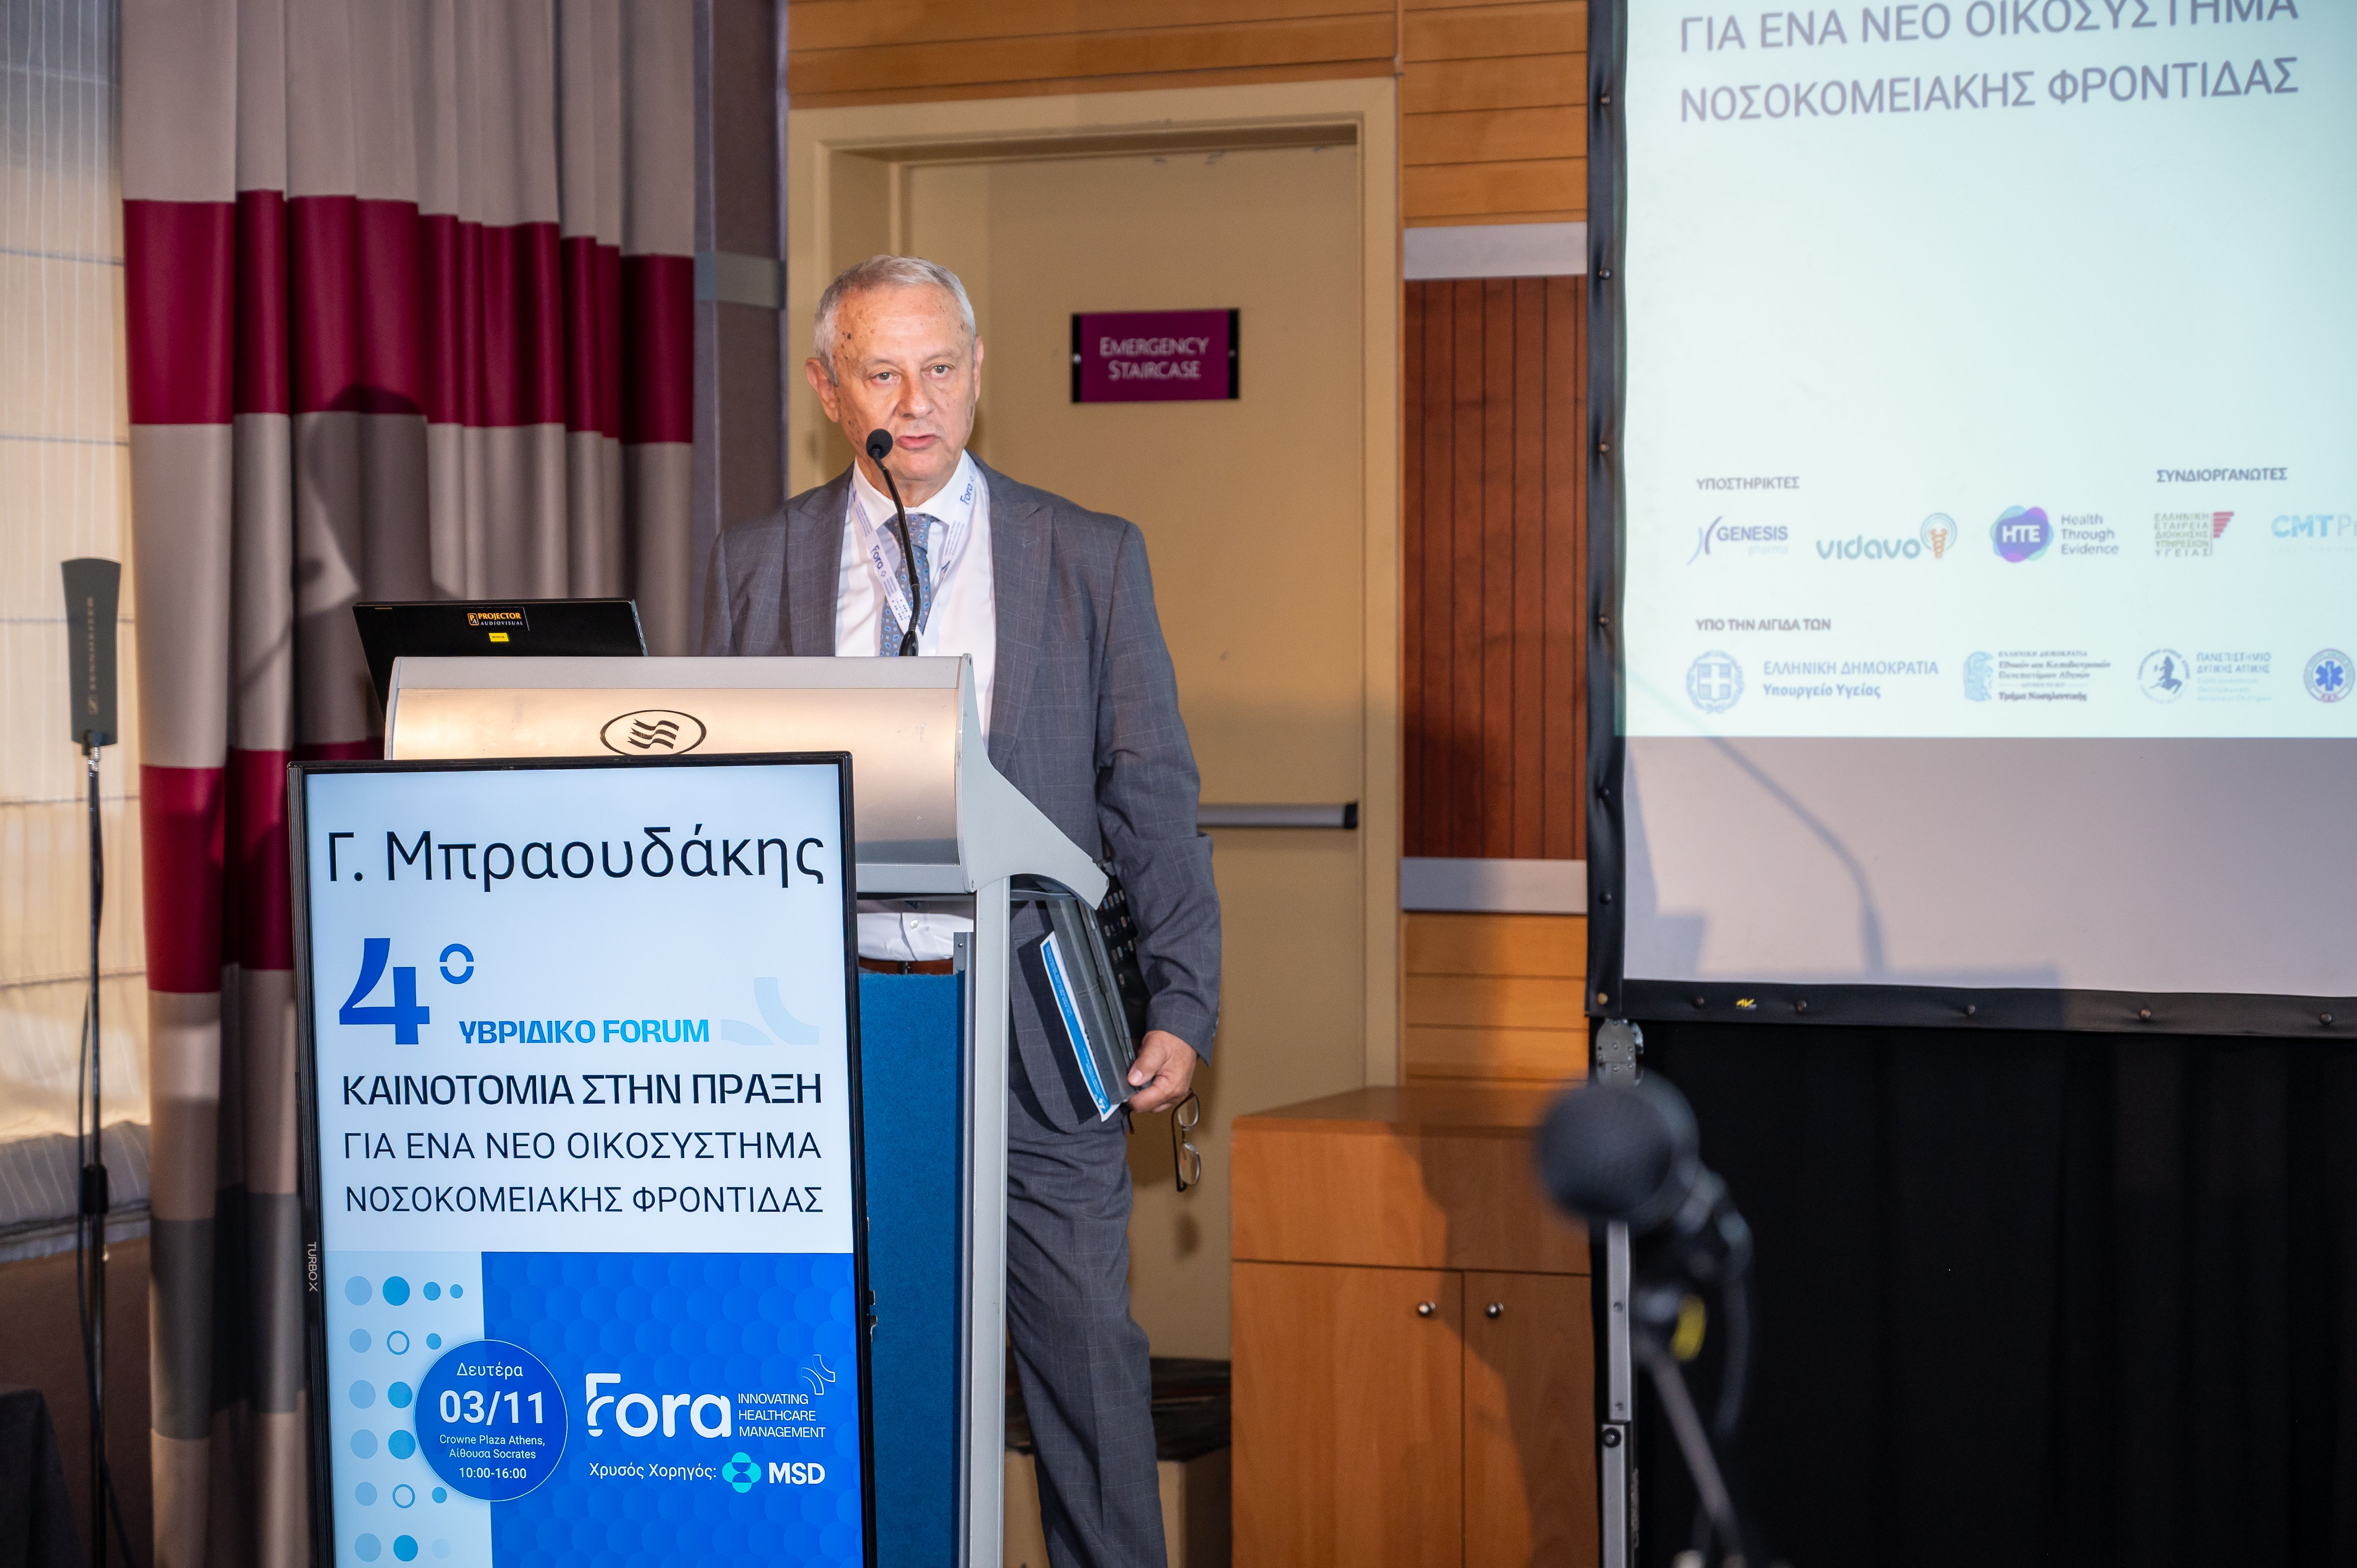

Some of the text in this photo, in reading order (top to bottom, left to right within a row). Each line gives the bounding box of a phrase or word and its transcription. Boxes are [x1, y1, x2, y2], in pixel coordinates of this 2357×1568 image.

[1681, 0, 2298, 52] ΓΙΑ ΕΝΑ ΝΕΟ ΟΙΚΟΣΥΣΤΗΜΑ
[1681, 57, 2298, 122] ΝΟΣΟΚΟΜΕΙΑΚΗΣ ΦΡΟΝΤΙΔΑΣ
[1100, 337, 1209, 358] EMERGENCY
[1108, 360, 1201, 381] STAIRCASE
[1697, 476, 1800, 490] ΥΠΟΣΤΗΡΙΚΤΕΣ
[2156, 467, 2288, 482] ΣΥΝΔΙΟΡΓΑΝΩΤΕΣ
[960, 484, 972, 505] Fora
[2061, 514, 2103, 526] Health
[1717, 526, 1788, 542] GENESIS
[2002, 524, 2041, 543] HTE
[2061, 528, 2114, 543] Through
[1816, 535, 1921, 560] vidavo
[2061, 542, 2119, 555] Evidence
[871, 545, 883, 570] Fora
[478, 612, 521, 620] PROJECTOR
[1696, 618, 1831, 631] ΥΠΟ ΤΗΝ ΑΙΓΙΔΑ ΤΩΝ
[1764, 660, 1938, 675] ΕΛΛΗΝΙΚΗ ΔΗΜΟΚΡΑΤΙΑ
[1763, 683, 1881, 699] Υπουργείο Υγείας
[328, 824, 824, 893] Γ. Μπραουδάκης
[459, 1019, 709, 1044] ΥΒΡΙΔΙΚΟ FORUM
[343, 1073, 821, 1105] ΚΑΙΝΟΤΟΜΙΑ ΣΤΗΝ ΠΡΑΞΗ
[344, 1132, 822, 1159] ΓΙΑ ΕΝΑ ΝΕΟ ΟΙΚΟΣΥΣΤΗΜΑ
[346, 1185, 823, 1213] ΝΟΣΟΚΟΜΕΙΑΚΗΣ ΦΡΟΝΤΙΔΑΣ
[456, 1362, 523, 1380] Δευτέρα
[440, 1390, 543, 1426] 03/11
[586, 1373, 732, 1438] Fora
[738, 1393, 808, 1405] INNOVATING
[739, 1410, 816, 1421] HEALTHCARE
[439, 1434, 545, 1446] Crowne Plaza Athens,
[739, 1426, 826, 1438] MANAGEMENT
[449, 1448, 536, 1459] Αίθουσα Socrates
[459, 1467, 527, 1479] 10:00-16:00
[590, 1462, 717, 1481] Χρυσός Χορηγός:
[769, 1463, 825, 1485] MSD
